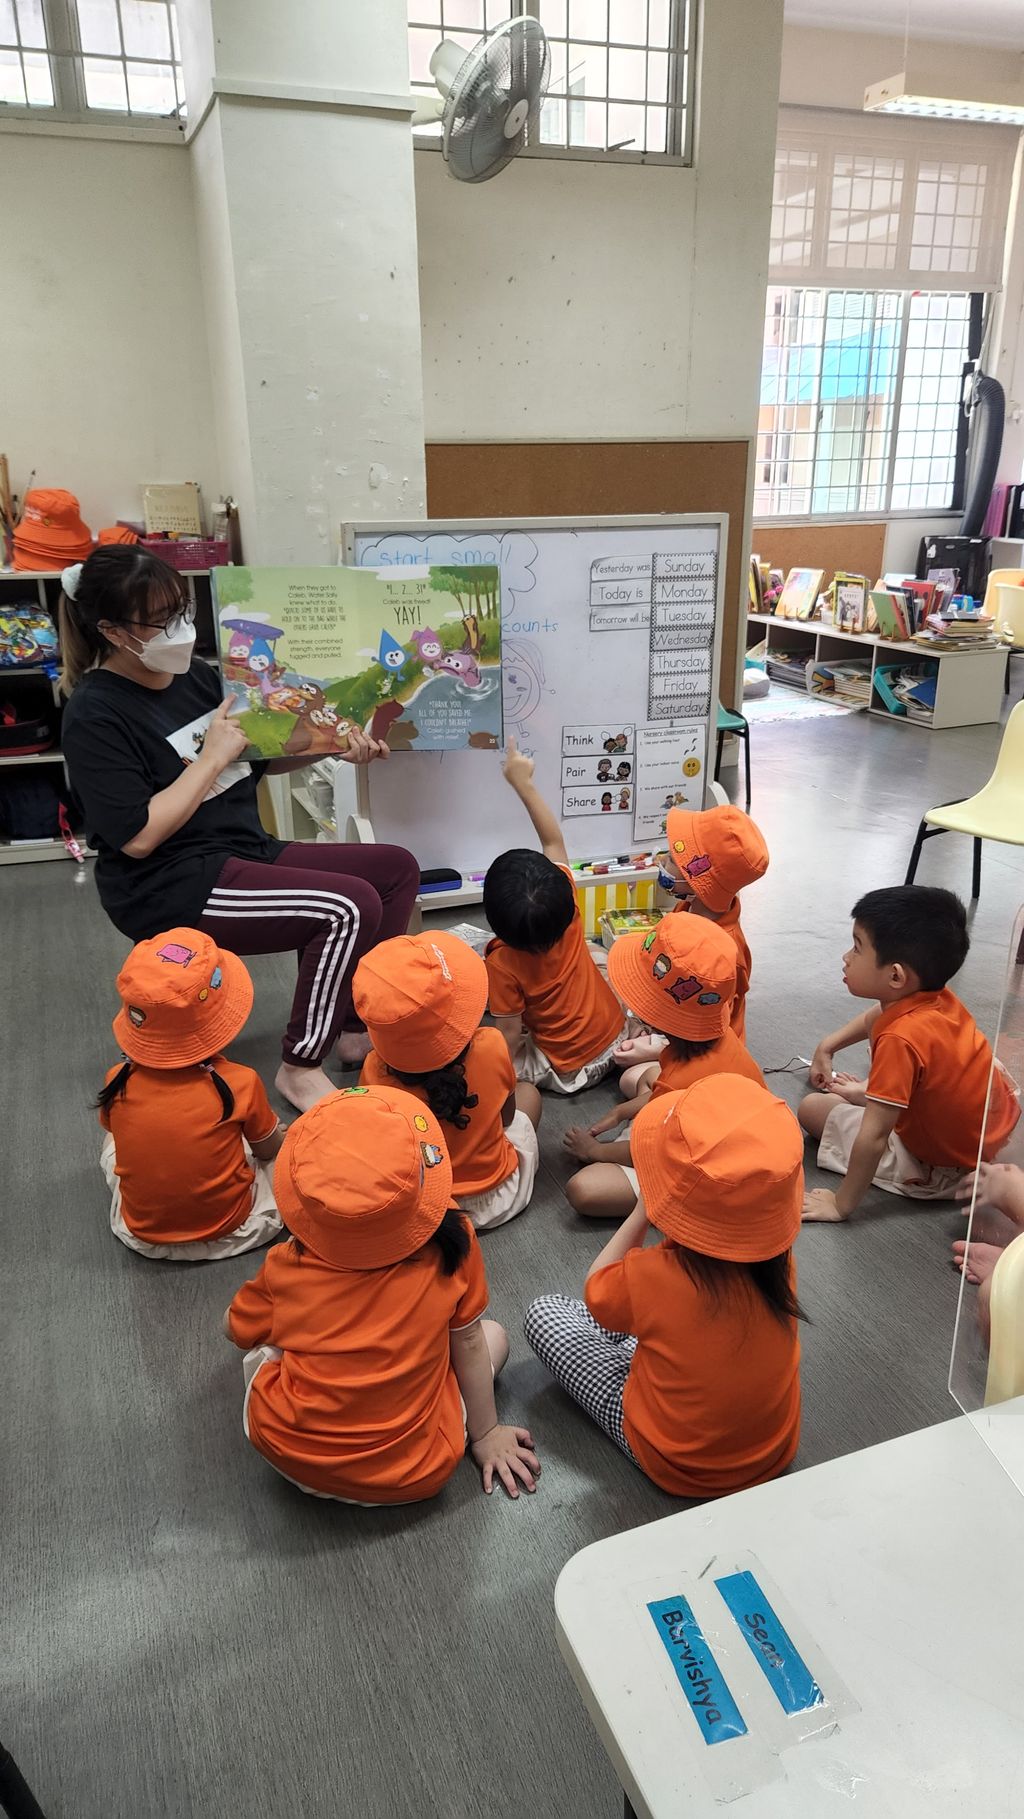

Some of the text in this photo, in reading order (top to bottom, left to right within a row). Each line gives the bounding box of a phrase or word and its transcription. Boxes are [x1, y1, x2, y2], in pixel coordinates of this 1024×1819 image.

[379, 546, 433, 566] start
[592, 562, 650, 575] Yesterday was
[664, 558, 706, 576] Sunday
[599, 586, 644, 602] Today is
[661, 583, 708, 601] Monday
[393, 605, 421, 625] YAY!
[592, 613, 650, 625] Tomorrow will be
[662, 608, 707, 625] Tuesday
[500, 619, 560, 634] counts
[655, 630, 709, 646] Wednesday
[657, 654, 706, 670] Thursday
[663, 677, 699, 692] Friday
[655, 700, 705, 715] Saturday
[565, 734, 594, 745] Think
[566, 766, 586, 777] Pair
[566, 796, 597, 808] Share
[743, 1611, 786, 1669] Sean
[661, 1609, 723, 1727] Barvishya
